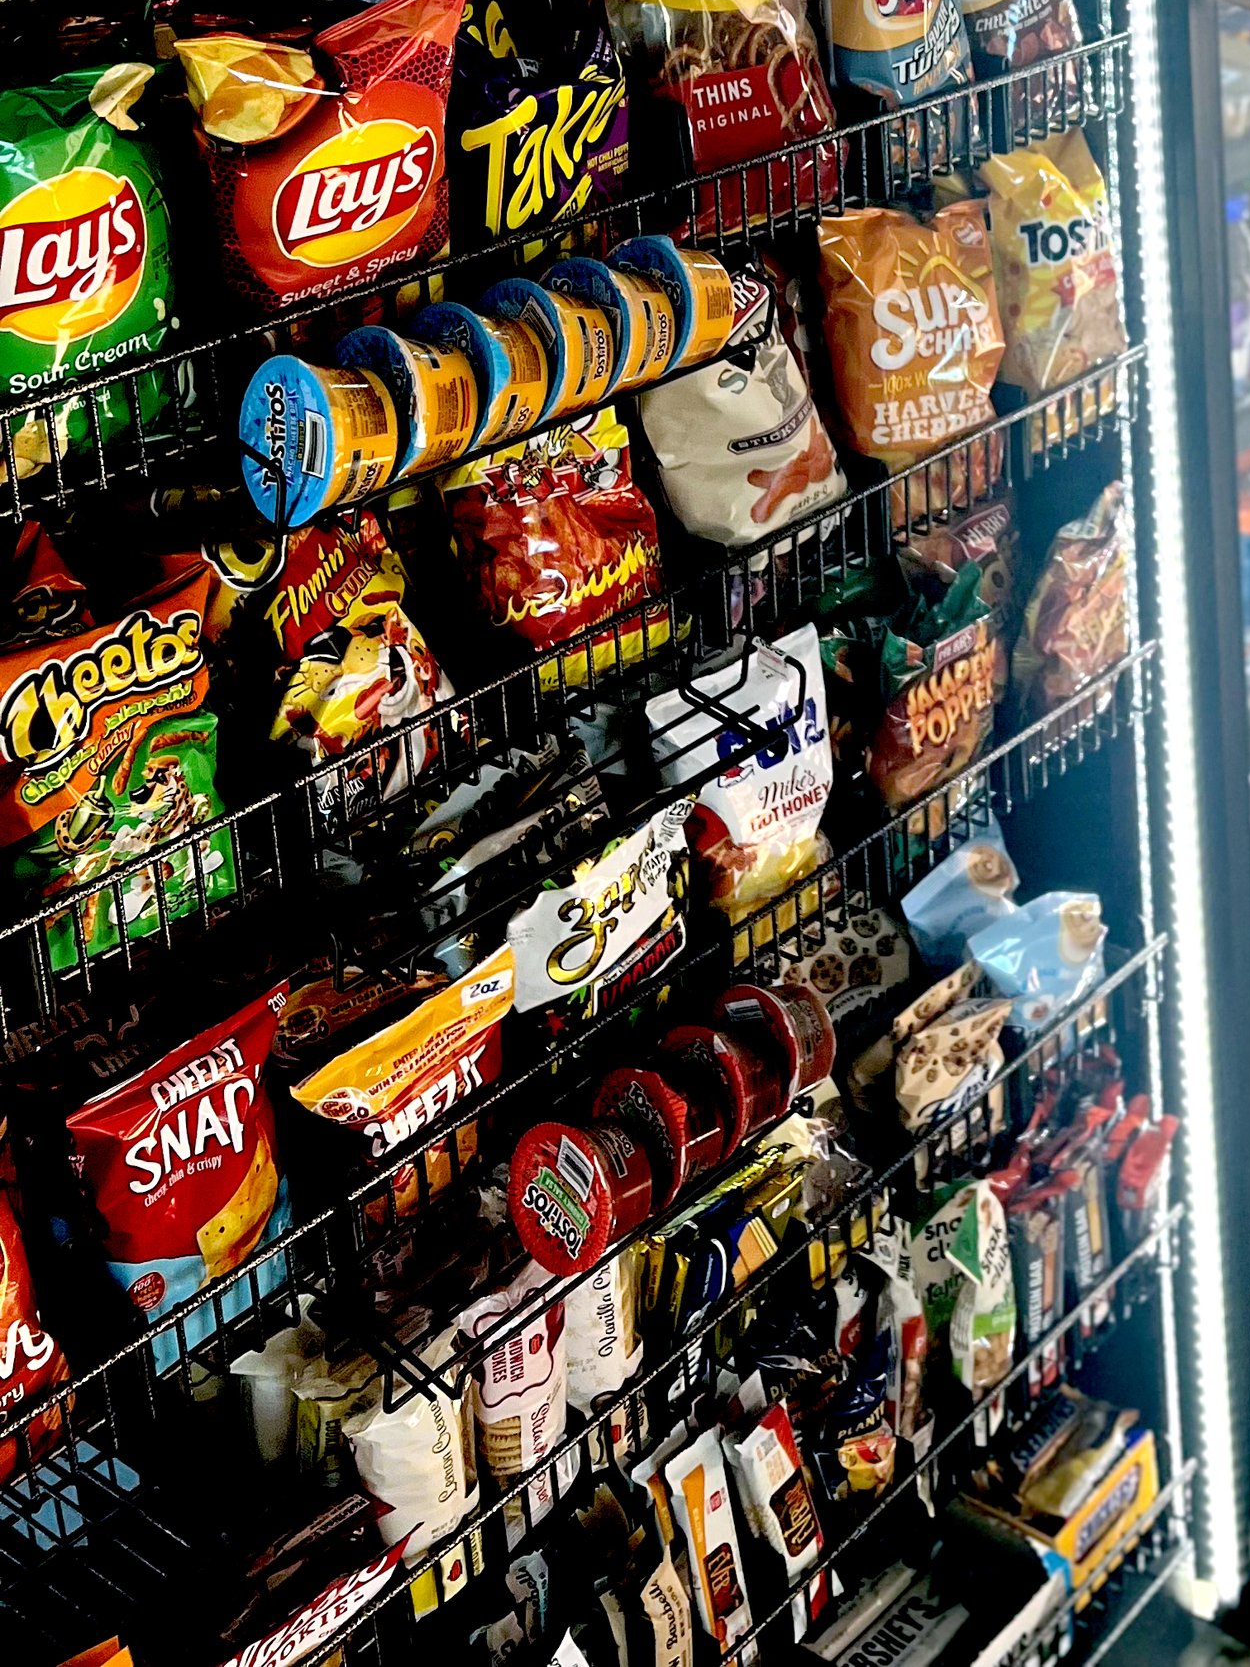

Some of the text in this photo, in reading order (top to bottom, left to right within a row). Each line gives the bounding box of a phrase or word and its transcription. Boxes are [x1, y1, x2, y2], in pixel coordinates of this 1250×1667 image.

[693, 77, 752, 110] THINS
[697, 104, 772, 134] RIGINAL
[287, 141, 430, 242] Lay's
[0, 194, 137, 308] Lay's
[279, 274, 341, 309] Sweet
[345, 265, 361, 281] &
[366, 245, 419, 274] Spicy
[9, 331, 153, 395] Sour Cream
[263, 539, 345, 652] Flamin'
[5, 617, 201, 765] Cheetos
[782, 779, 832, 818] HONEY
[266, 991, 288, 1014] 210
[368, 1078, 391, 1096] WIN
[196, 1154, 223, 1174] crispy
[925, 1217, 962, 1241] sna
[981, 1225, 1003, 1275] snak
[597, 1295, 615, 1358] Vanilla
[510, 1332, 524, 1383] NDWICH
